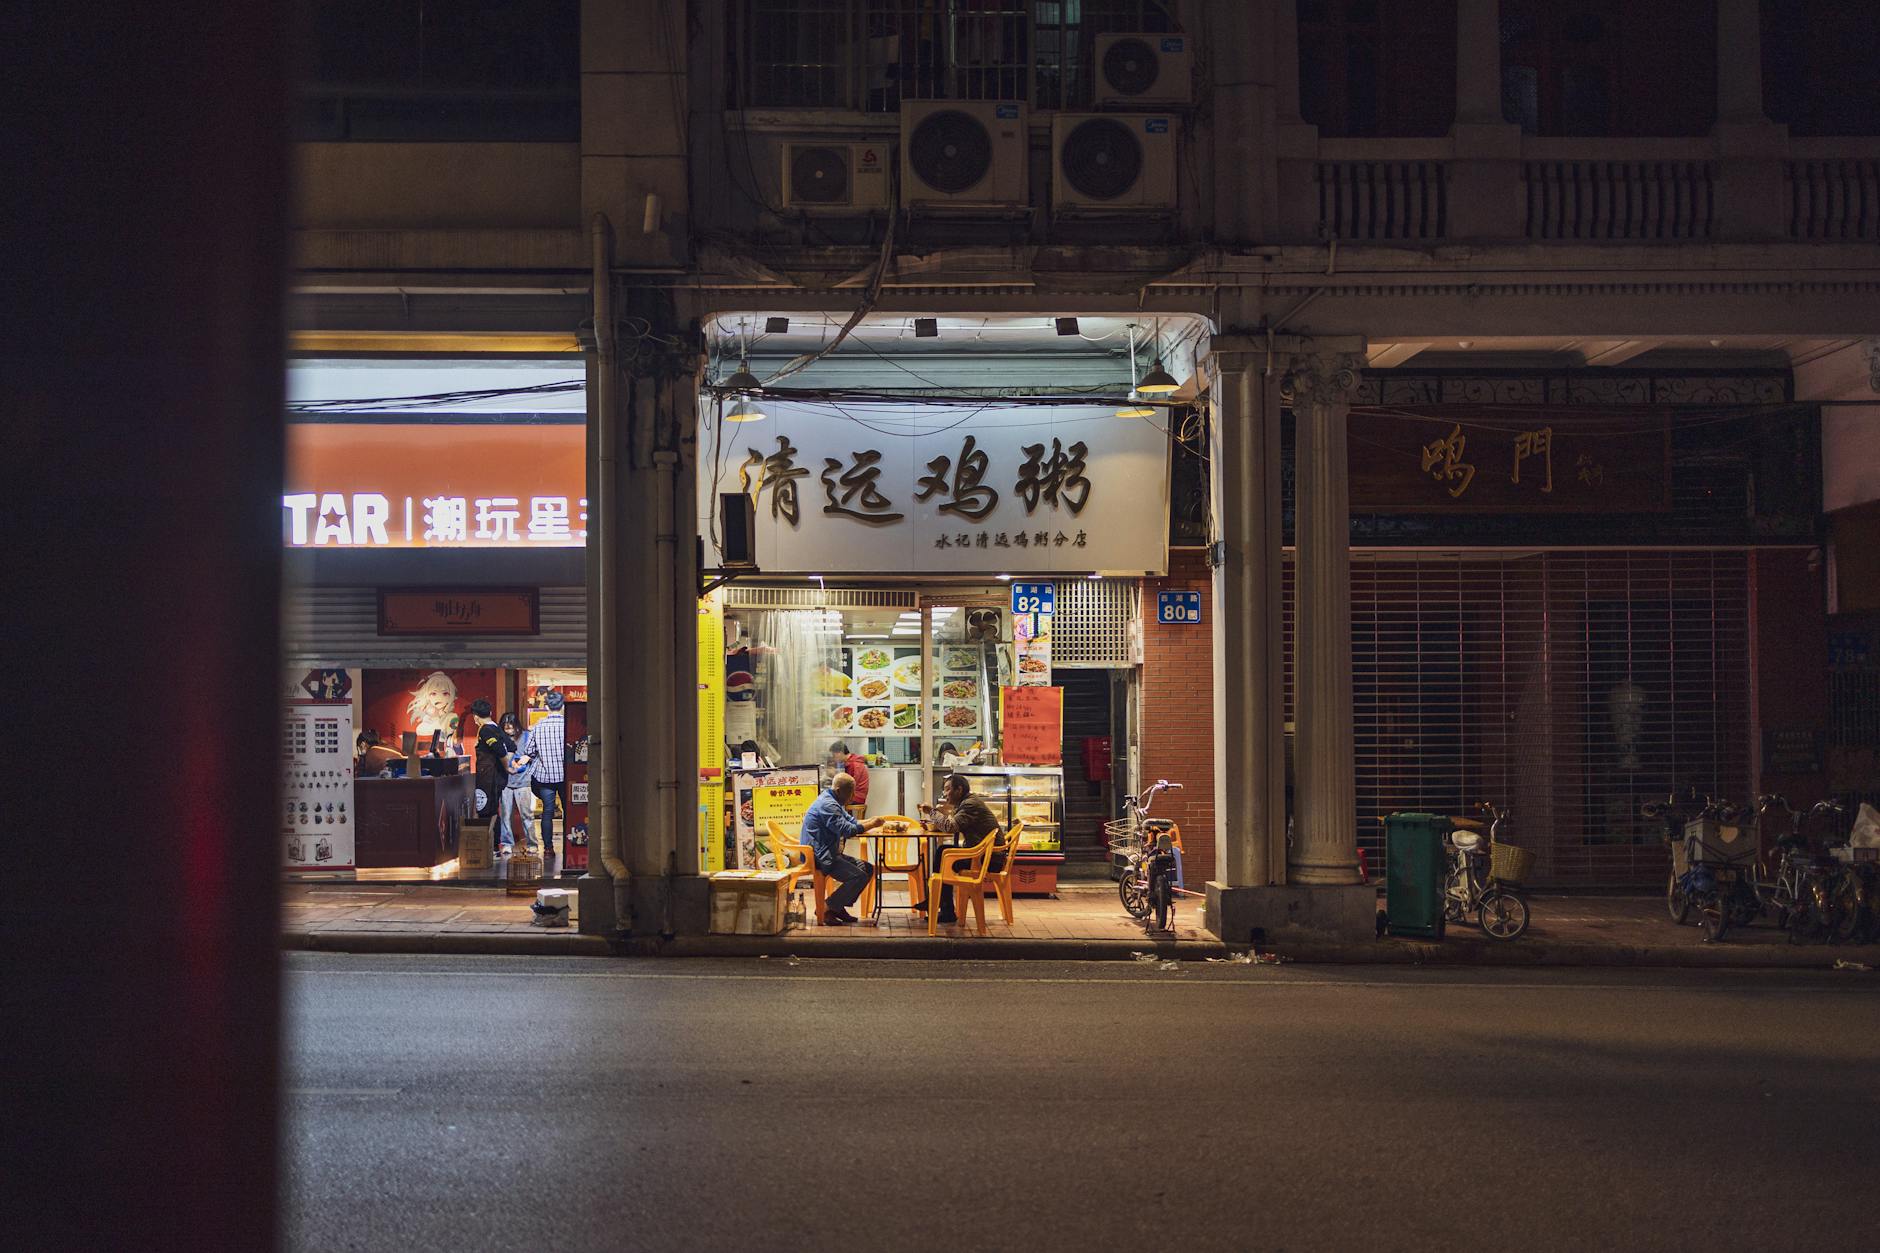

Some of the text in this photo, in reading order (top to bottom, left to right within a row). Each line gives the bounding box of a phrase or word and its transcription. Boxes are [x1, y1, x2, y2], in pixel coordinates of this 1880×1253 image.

[740, 434, 1092, 526] 清远鸡粥
[423, 496, 587, 542] 潮玩星
[935, 528, 1088, 549] 水记清远鸡粥分店
[1017, 596, 1040, 612] 82
[1163, 605, 1186, 621] 80
[573, 785, 589, 793] 周边
[573, 793, 589, 801] 售点
